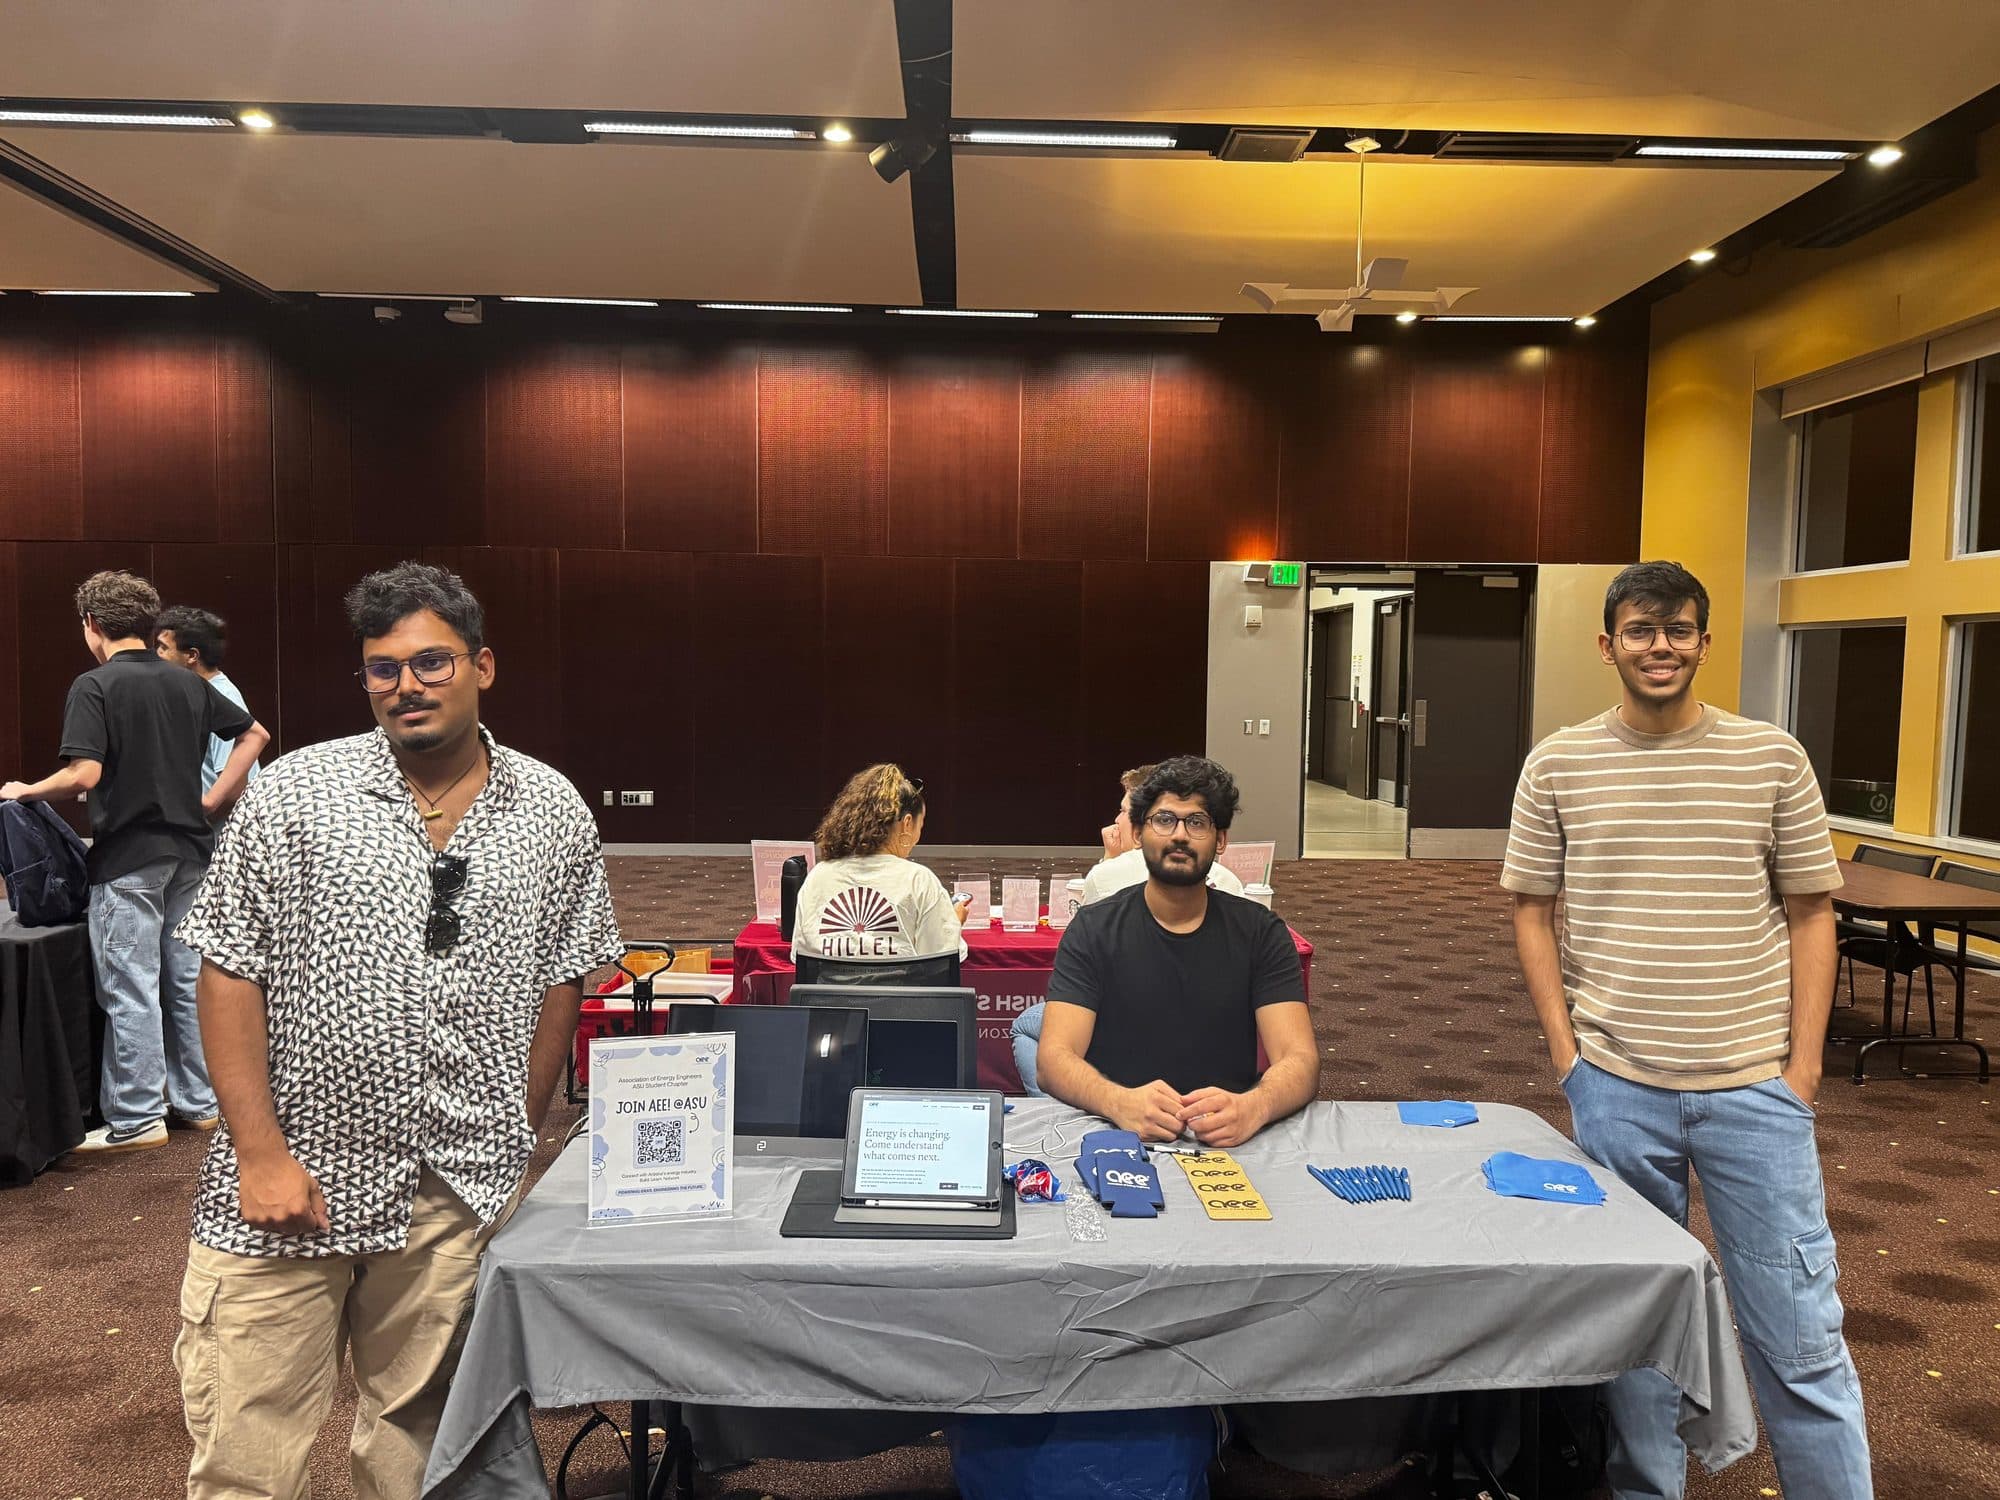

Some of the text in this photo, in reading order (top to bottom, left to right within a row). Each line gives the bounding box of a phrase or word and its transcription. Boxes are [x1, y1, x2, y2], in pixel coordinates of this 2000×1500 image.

[822, 936, 898, 957] HILLEL
[618, 1076, 650, 1084] Association
[656, 1074, 675, 1082] Energy
[616, 1096, 707, 1114] JOIN AEE! @ASU
[865, 1128, 951, 1141] Energy is changing.
[864, 1139, 944, 1150] Come understand
[863, 1151, 941, 1162] what comes next.
[1273, 1264, 1299, 1285] EXIT
